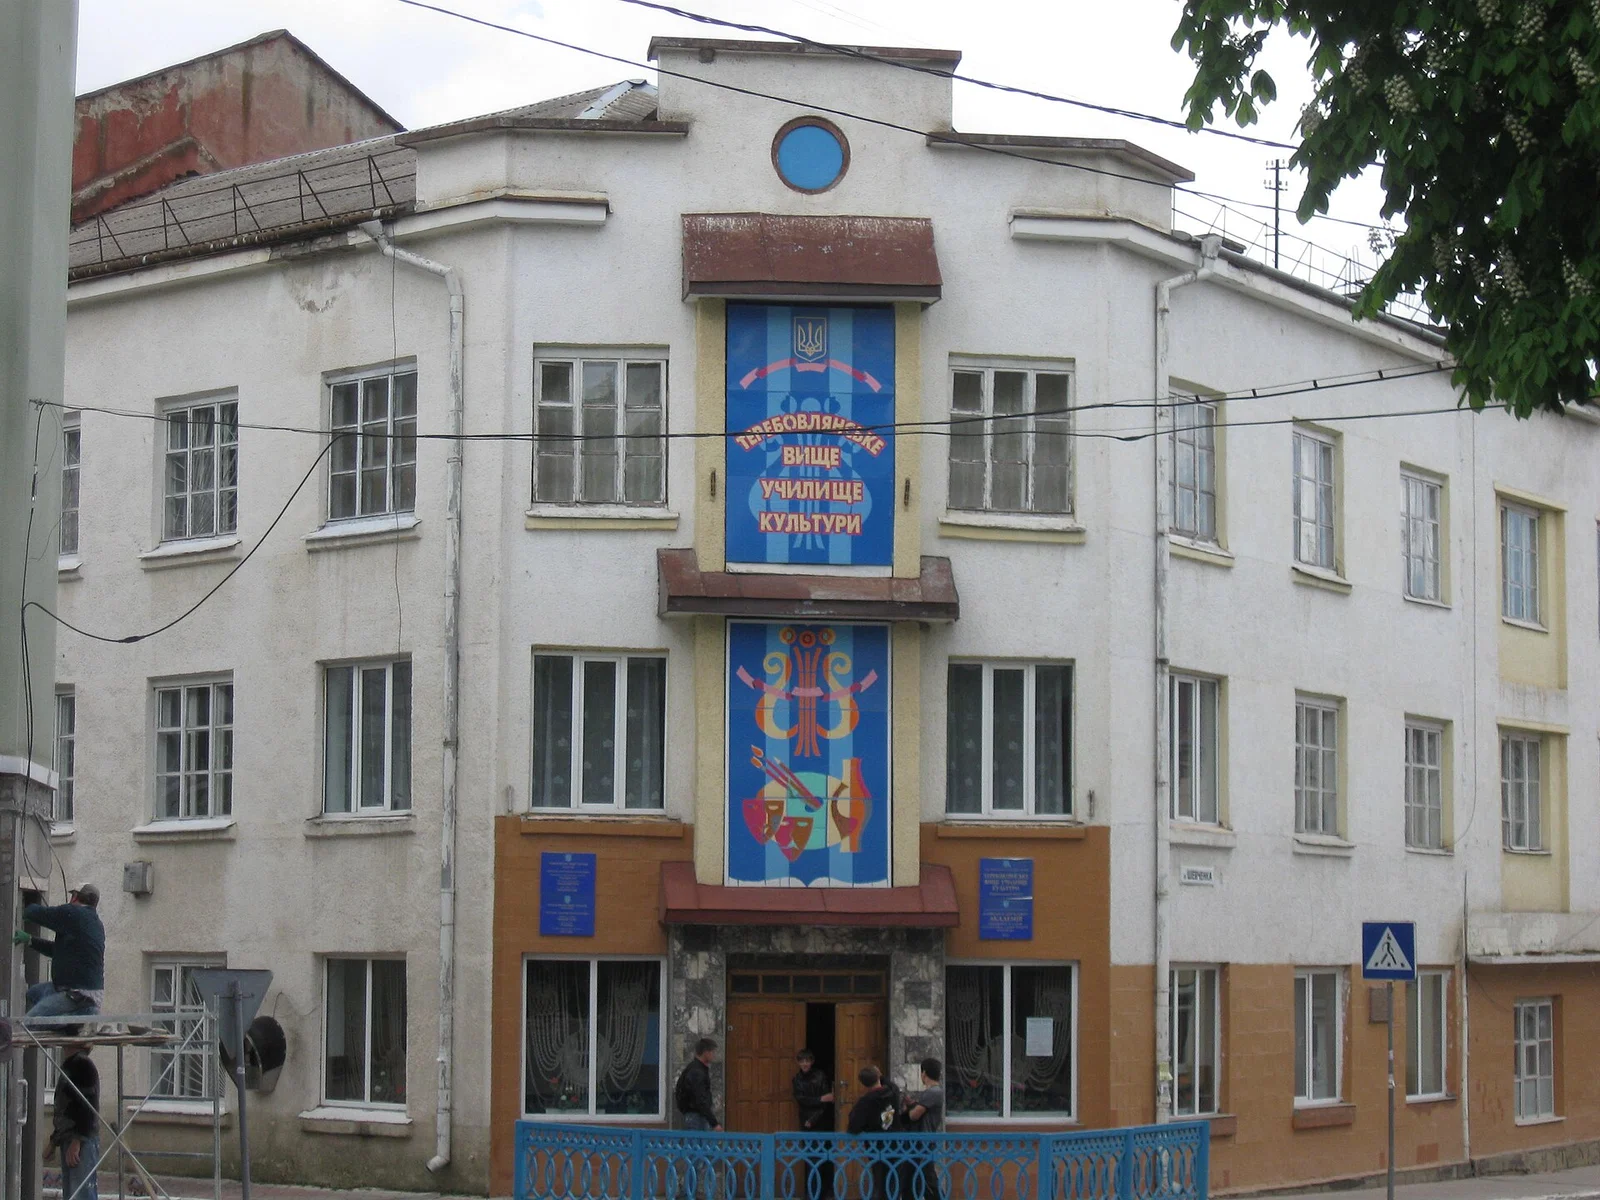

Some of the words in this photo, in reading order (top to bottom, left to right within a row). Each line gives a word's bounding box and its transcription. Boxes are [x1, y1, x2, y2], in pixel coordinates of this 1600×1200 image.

[734, 411, 887, 456] ТЕРЕБОВЛЯНСЬКЕ
[782, 446, 841, 469] ВИЩЕ
[760, 479, 863, 504] УЧИЛИЩЕ
[759, 511, 862, 535] КУЛЬТУРИ
